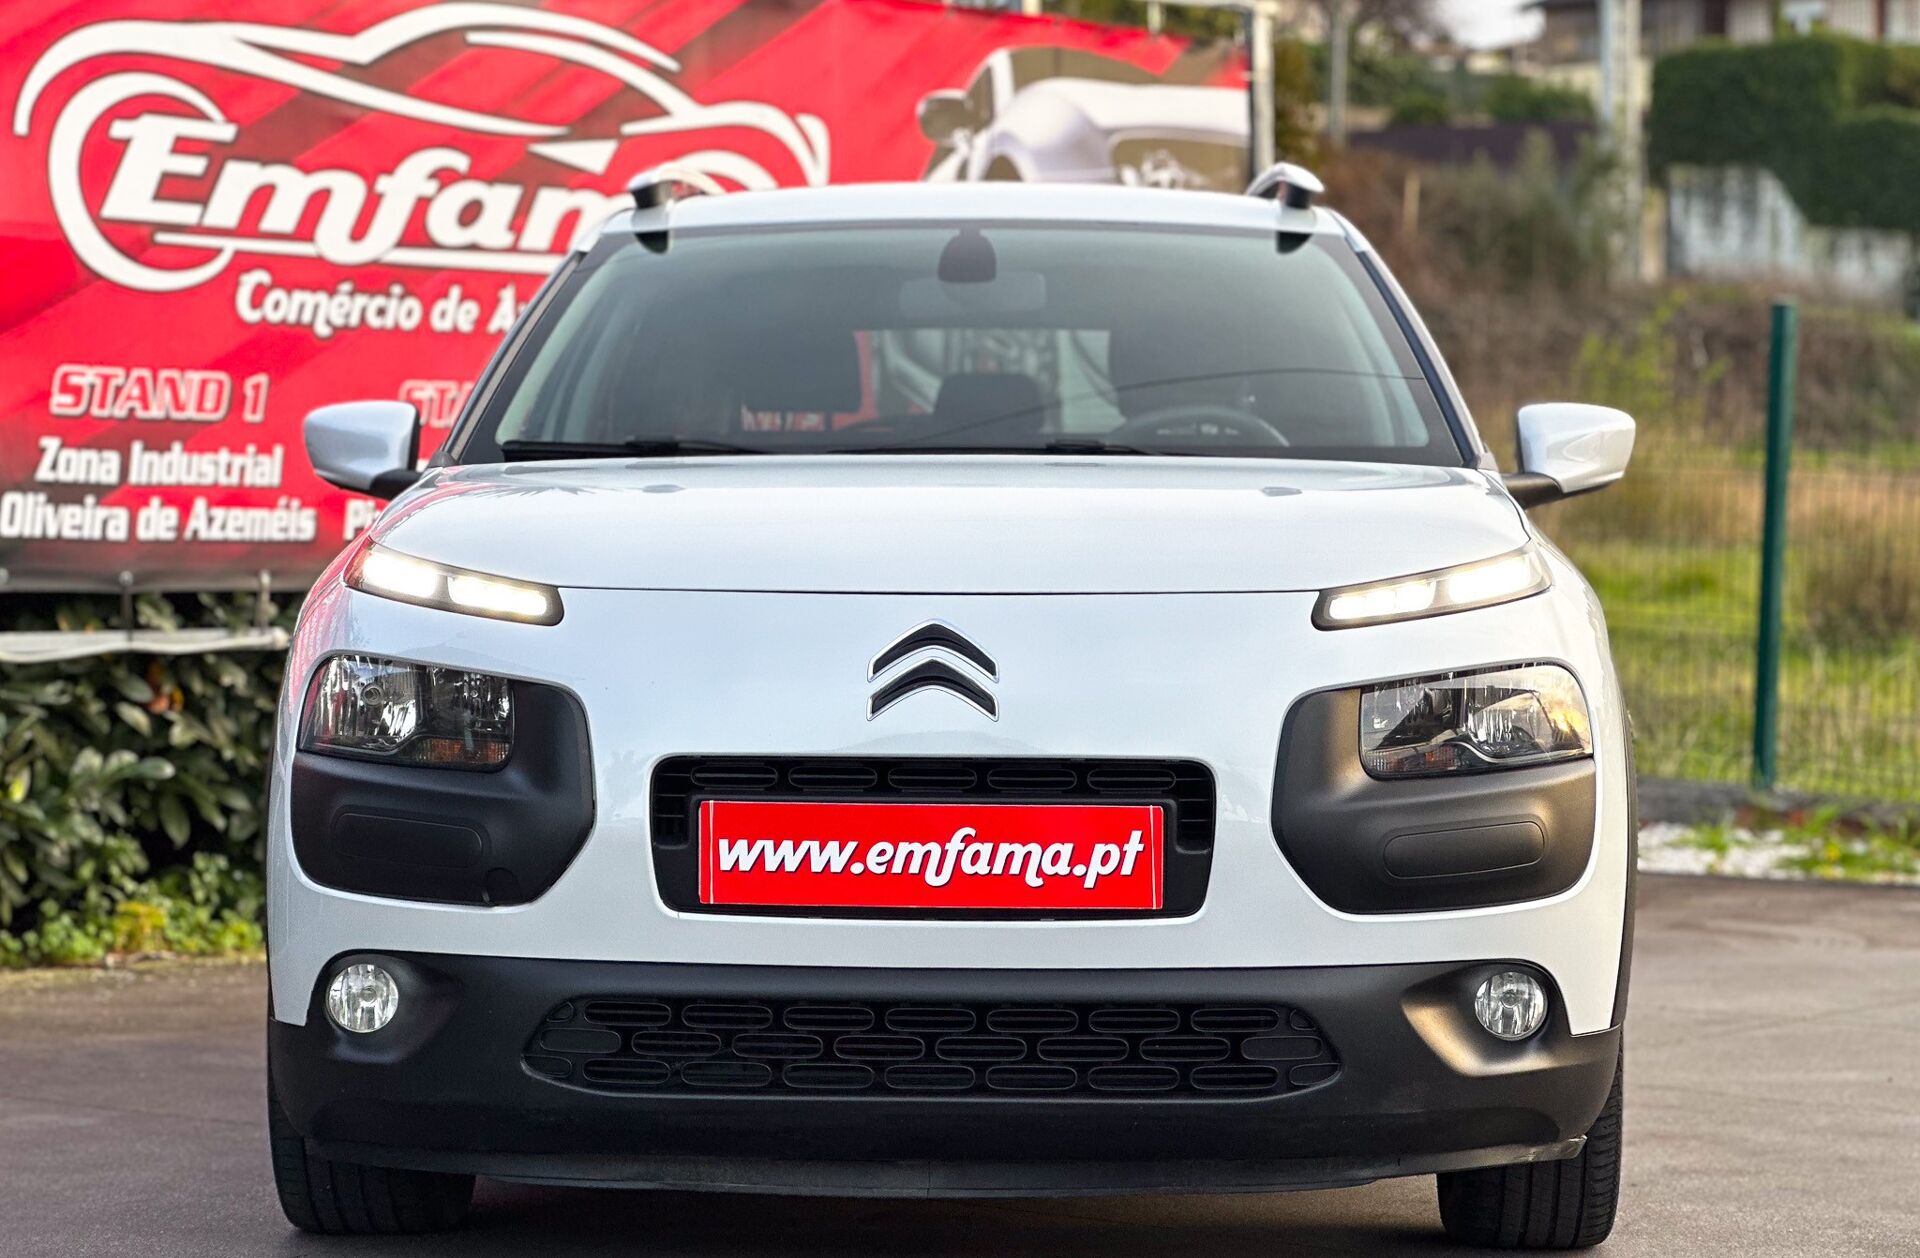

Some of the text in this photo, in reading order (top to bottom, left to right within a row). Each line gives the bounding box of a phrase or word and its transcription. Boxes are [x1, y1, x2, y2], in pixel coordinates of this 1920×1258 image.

[235, 268, 423, 338] Comércio
[429, 284, 480, 334] de
[49, 364, 269, 423] STAND 1
[34, 435, 285, 488] Zona Industrial
[0, 491, 318, 542] Oliveira de Azeméis
[717, 826, 1145, 890] www.emfama.pt
